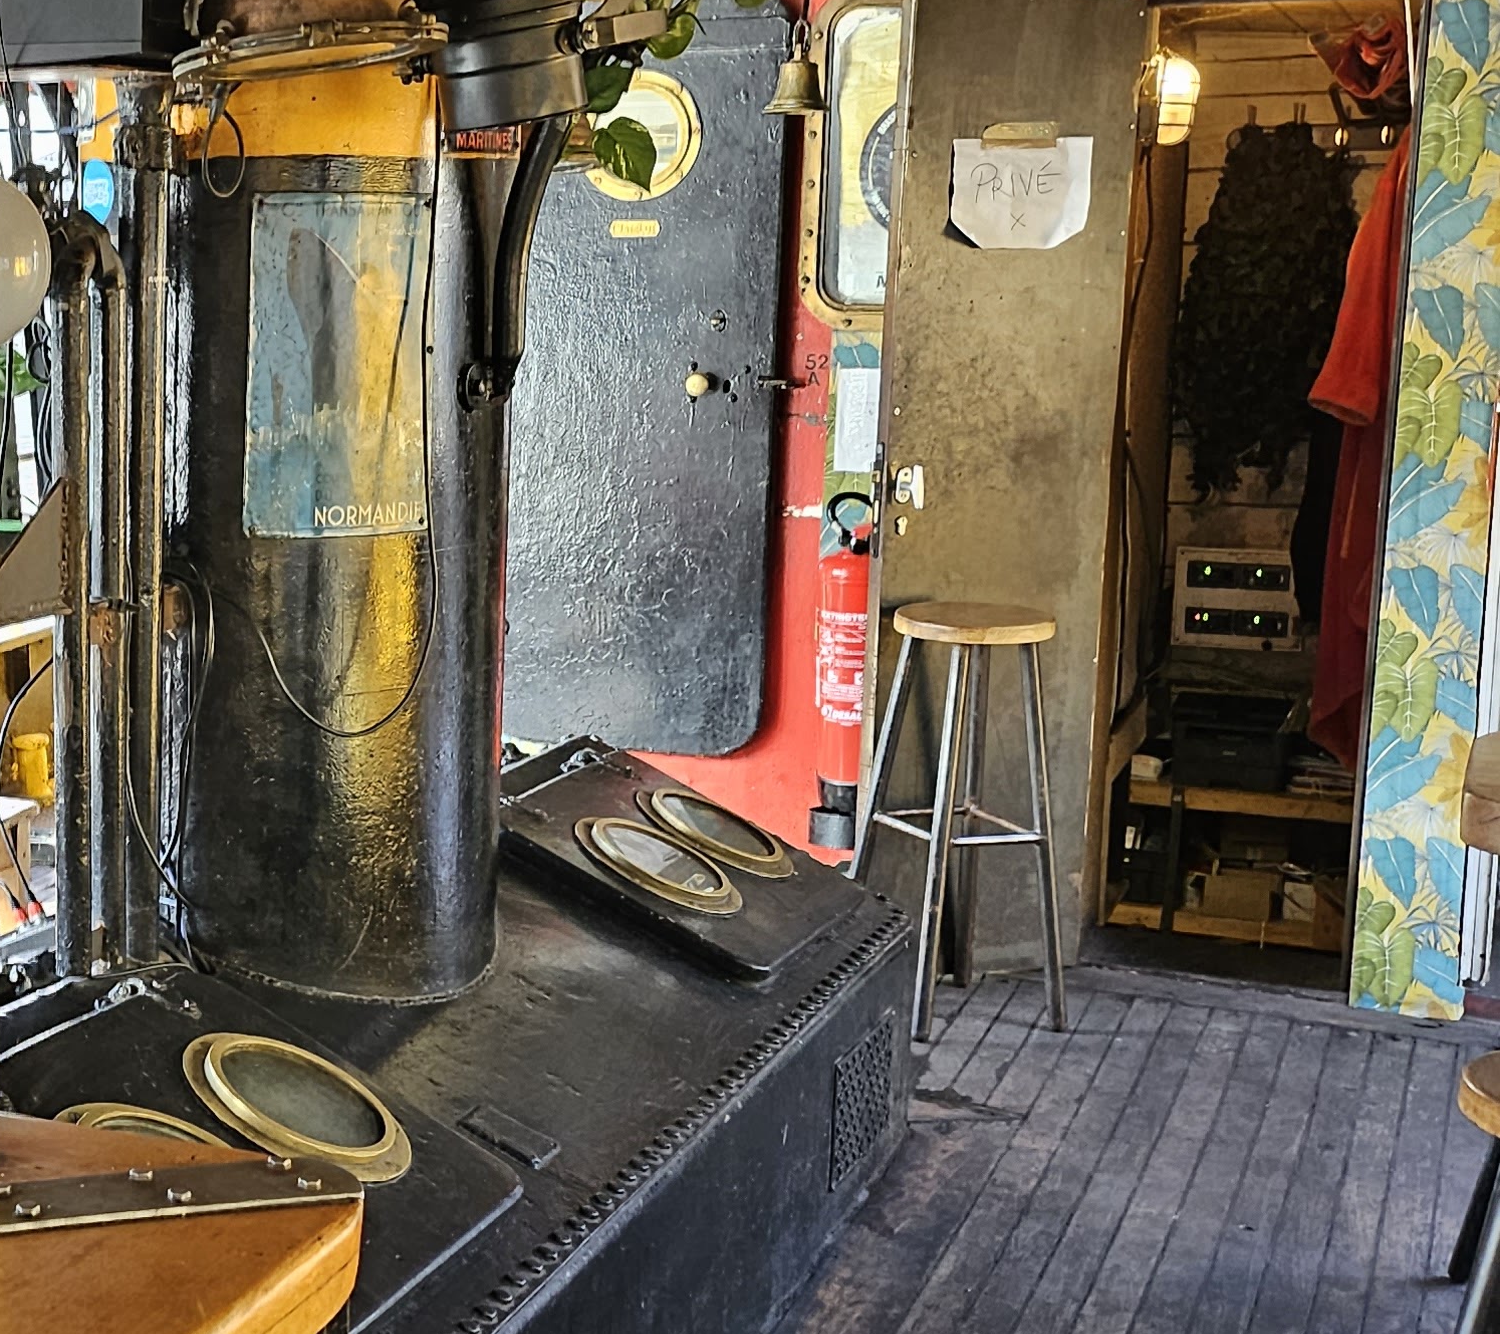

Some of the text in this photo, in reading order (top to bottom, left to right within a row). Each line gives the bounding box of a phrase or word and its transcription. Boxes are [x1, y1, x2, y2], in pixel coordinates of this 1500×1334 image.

[971, 160, 1062, 203] PRIVÉ
[805, 353, 828, 370] 52
[808, 371, 820, 386] A
[314, 502, 423, 527] NORMANDIE
